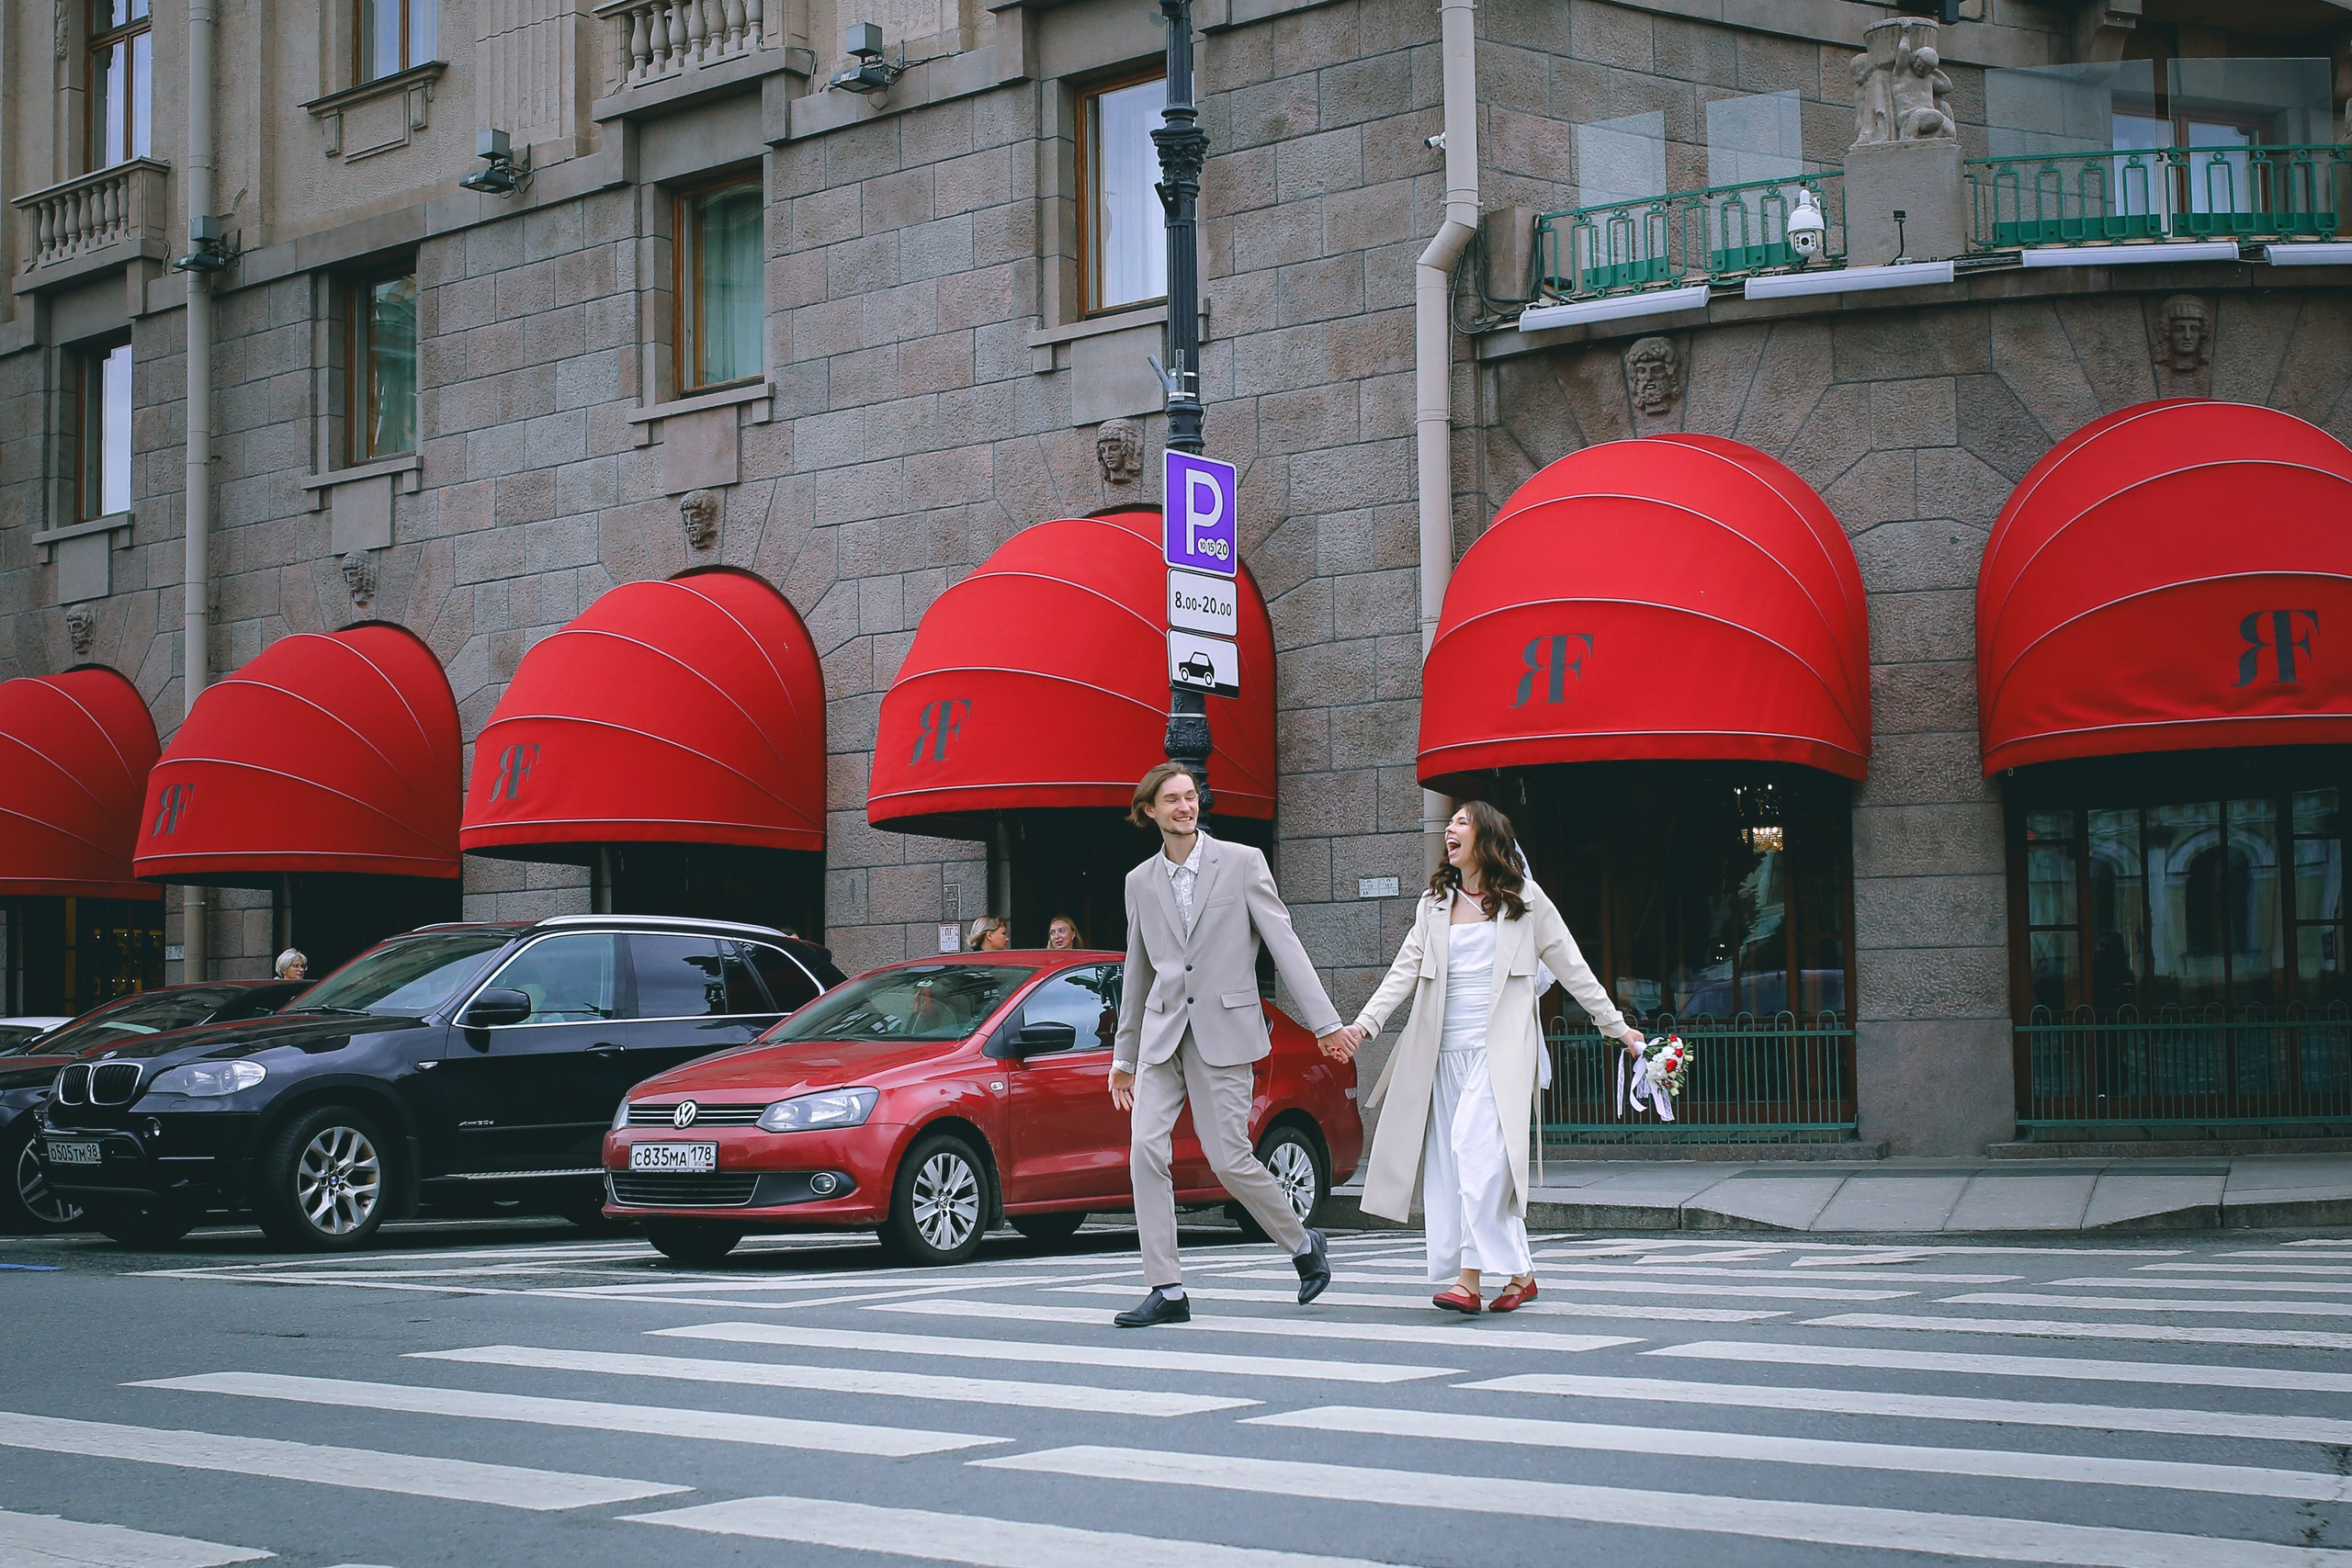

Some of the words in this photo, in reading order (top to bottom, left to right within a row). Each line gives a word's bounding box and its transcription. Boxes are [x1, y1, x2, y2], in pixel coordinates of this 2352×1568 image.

[1185, 468, 1224, 556] P
[1217, 543, 1227, 556] 20
[87, 1145, 97, 1157] 98
[691, 1146, 712, 1161] 178
